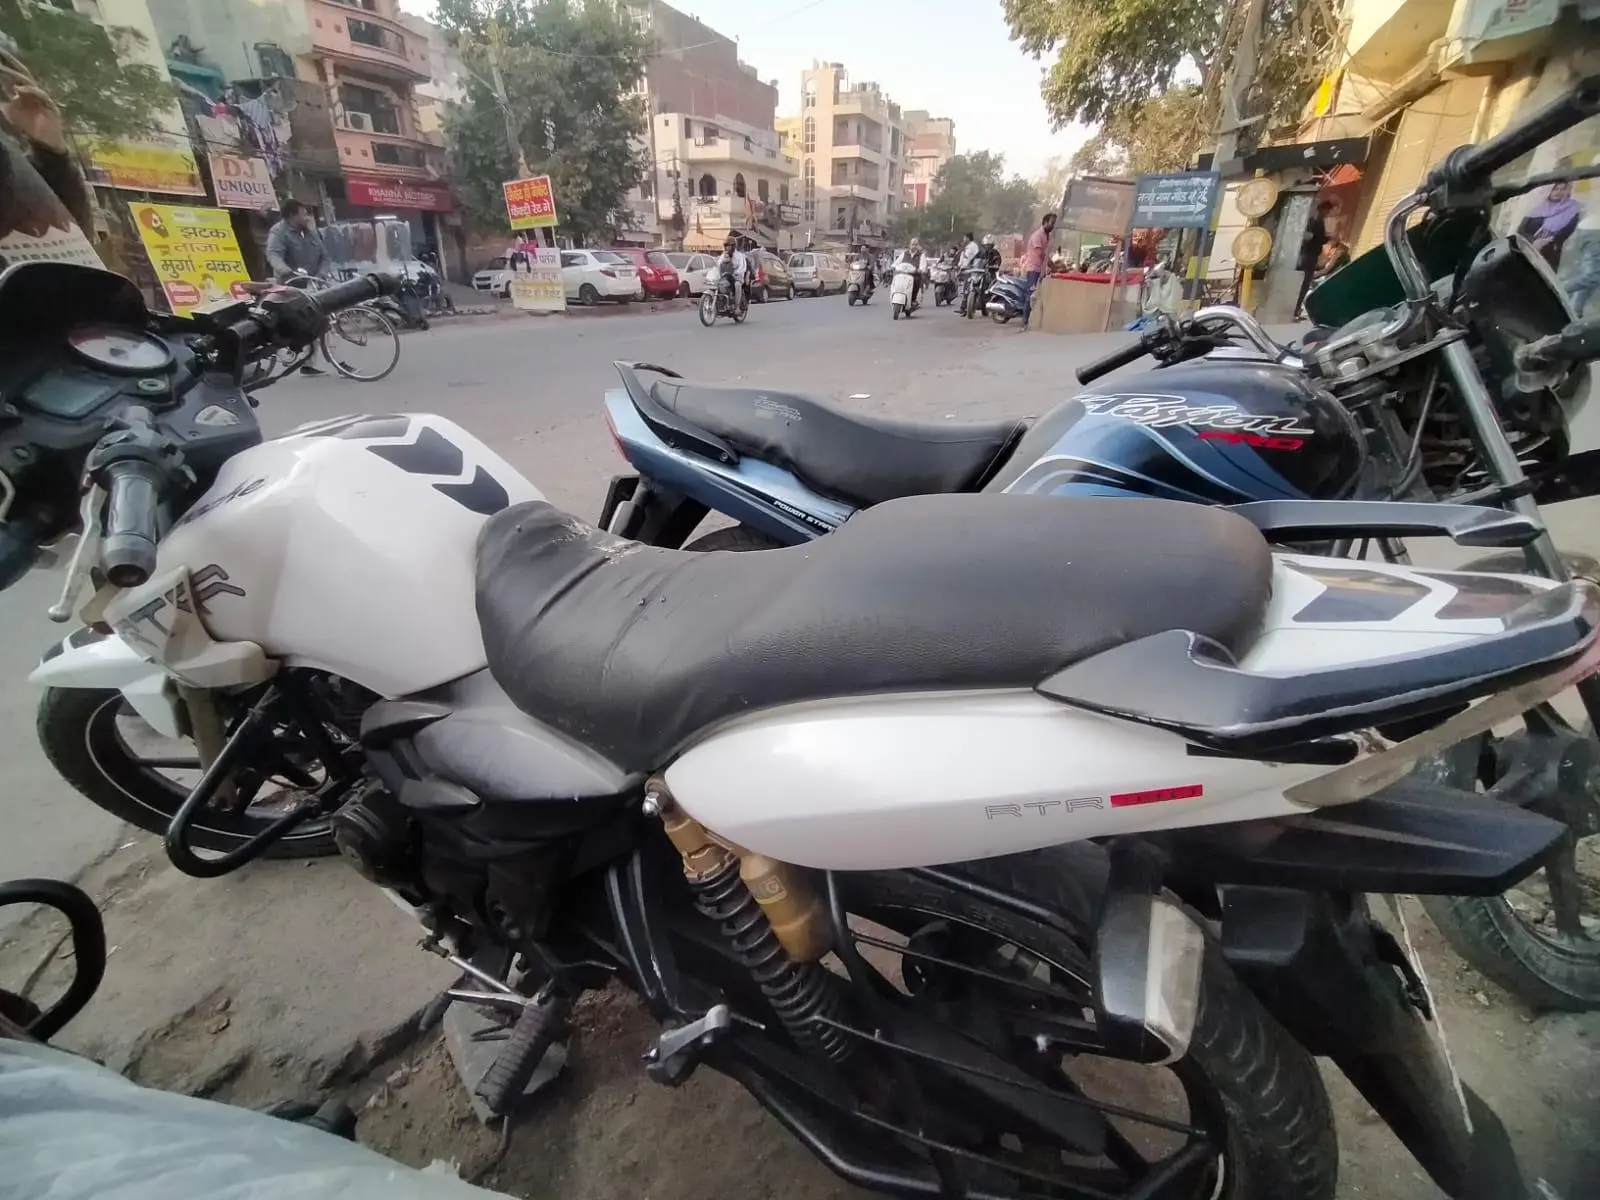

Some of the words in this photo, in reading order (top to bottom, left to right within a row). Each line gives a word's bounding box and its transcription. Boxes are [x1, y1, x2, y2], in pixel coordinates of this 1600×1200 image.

[222, 158, 257, 178] DJ
[219, 179, 271, 196] UNIQUE
[1073, 393, 1315, 434] Passion
[773, 500, 806, 519] POWER
[985, 796, 1104, 820] RTR
